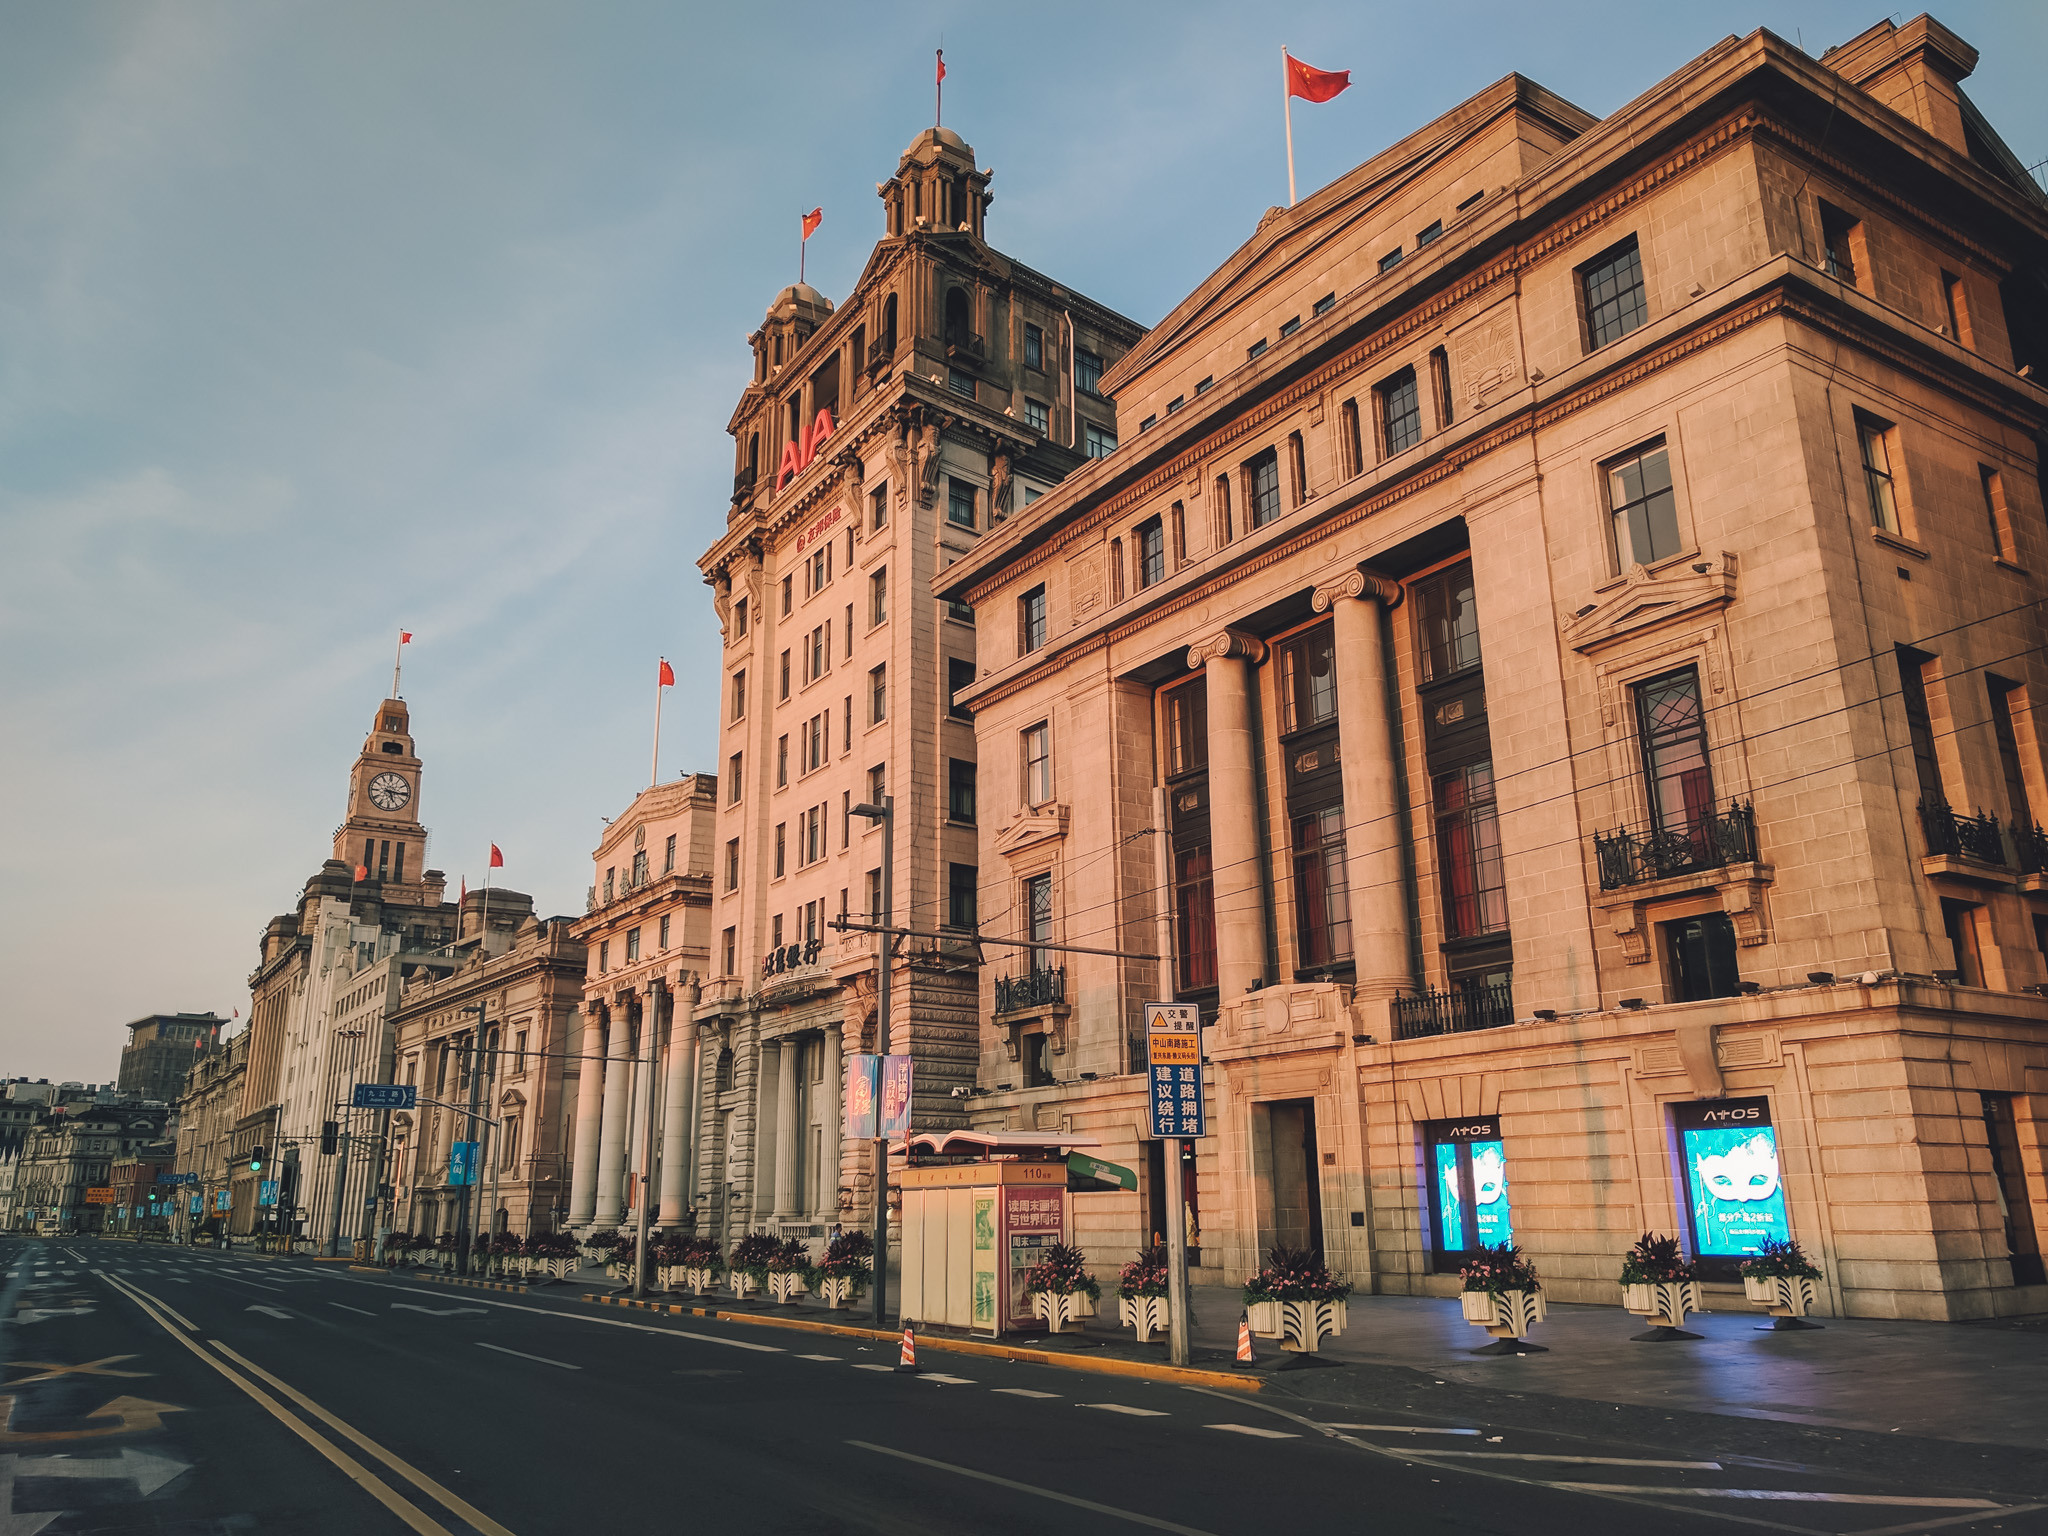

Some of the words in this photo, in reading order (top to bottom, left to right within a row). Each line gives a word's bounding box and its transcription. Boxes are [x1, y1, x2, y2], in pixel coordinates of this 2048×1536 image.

[776, 408, 835, 493] AIA
[807, 505, 842, 544] 友邦保险
[1167, 1009, 1189, 1019] 交警
[1173, 1021, 1195, 1031] 提醒
[1152, 1037, 1196, 1049] 中山南路施工
[368, 1090, 399, 1098] 九江路
[1156, 1066, 1175, 1134] 建议绕行
[1178, 1066, 1198, 1134] 道路拥堵
[1008, 1199, 1060, 1212] 读周末画报
[1008, 1213, 1060, 1227] 与世界同行
